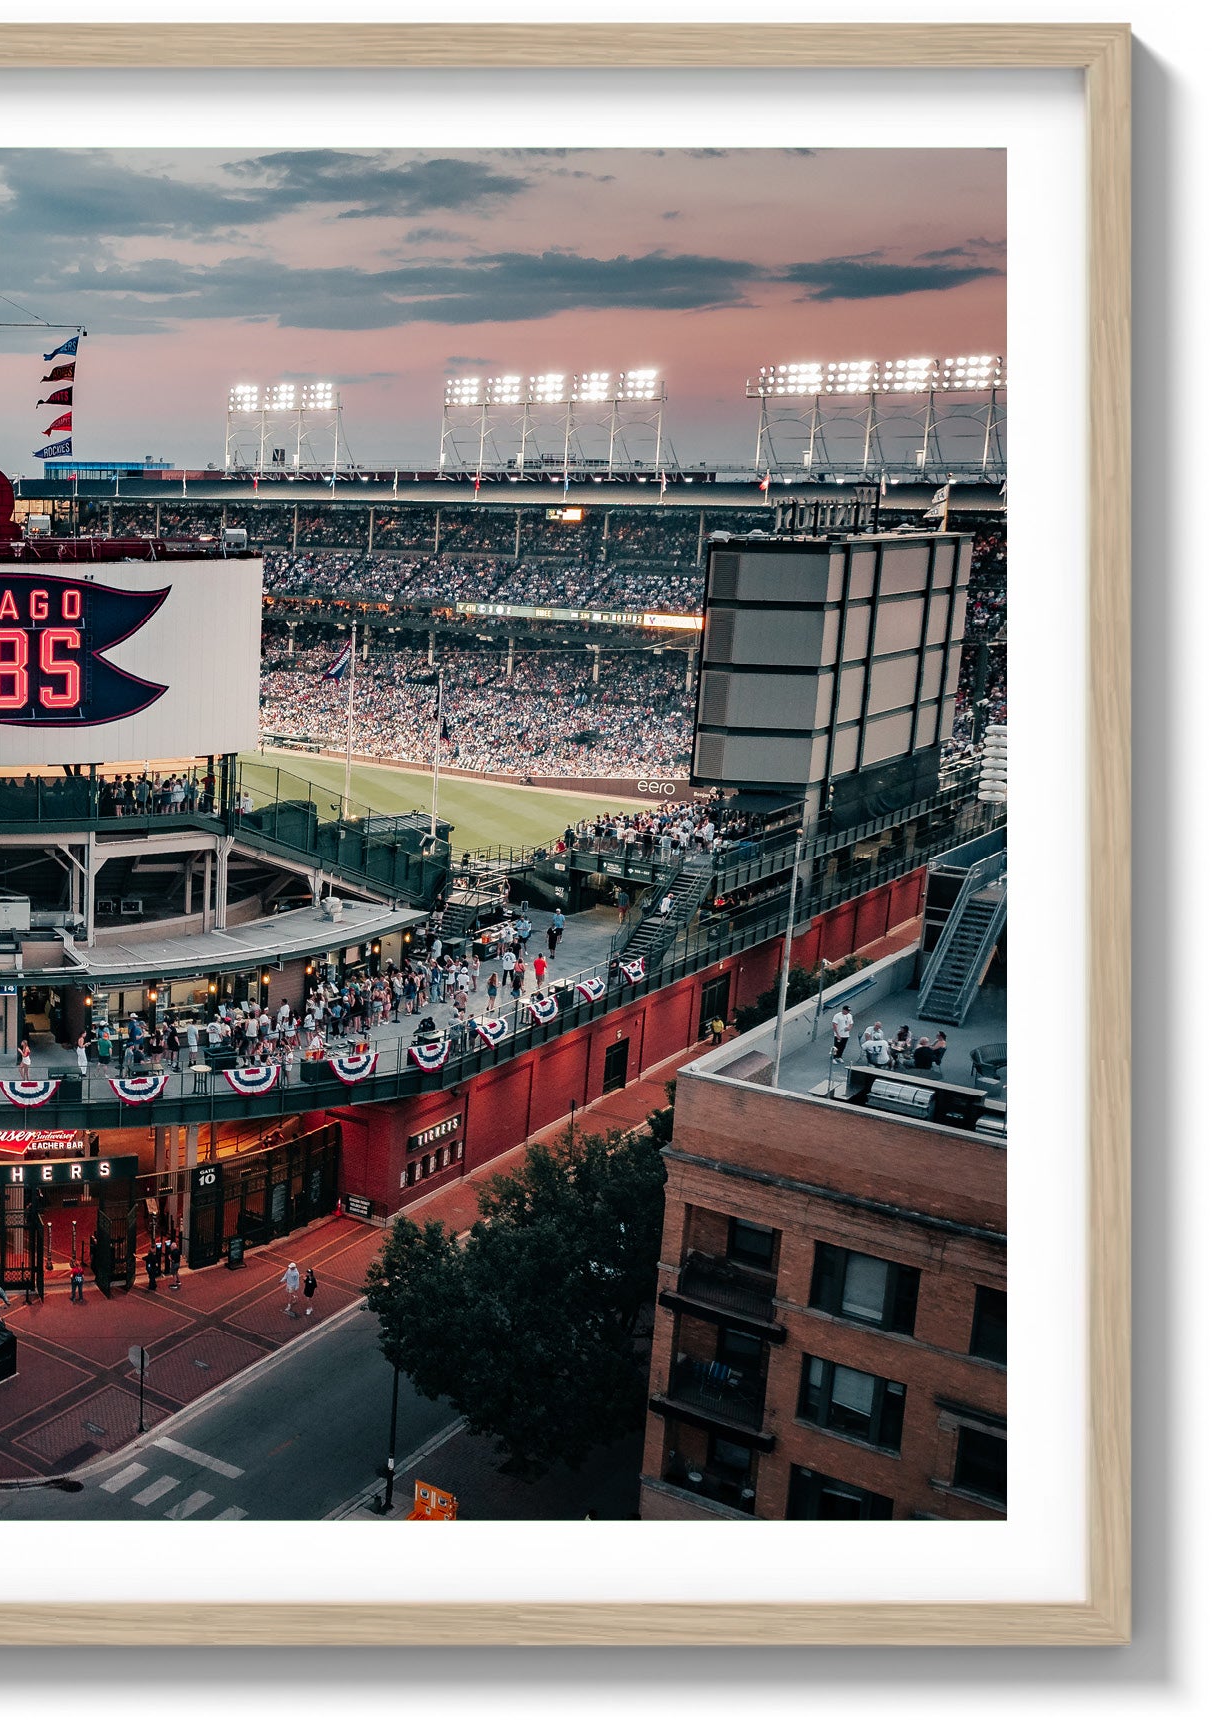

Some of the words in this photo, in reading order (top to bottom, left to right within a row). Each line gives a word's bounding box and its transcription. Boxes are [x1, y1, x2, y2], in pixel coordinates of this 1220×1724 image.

[50, 391, 69, 401] ANTS
[43, 442, 70, 457] ROCKIES
[637, 780, 675, 795] eero
[873, 1045, 883, 1053] 17
[417, 1117, 459, 1147] TICKETS
[27, 1142, 65, 1151] LEACHER
[66, 1141, 84, 1149] BAR
[199, 1167, 216, 1175] GATE
[198, 1173, 216, 1186] 10
